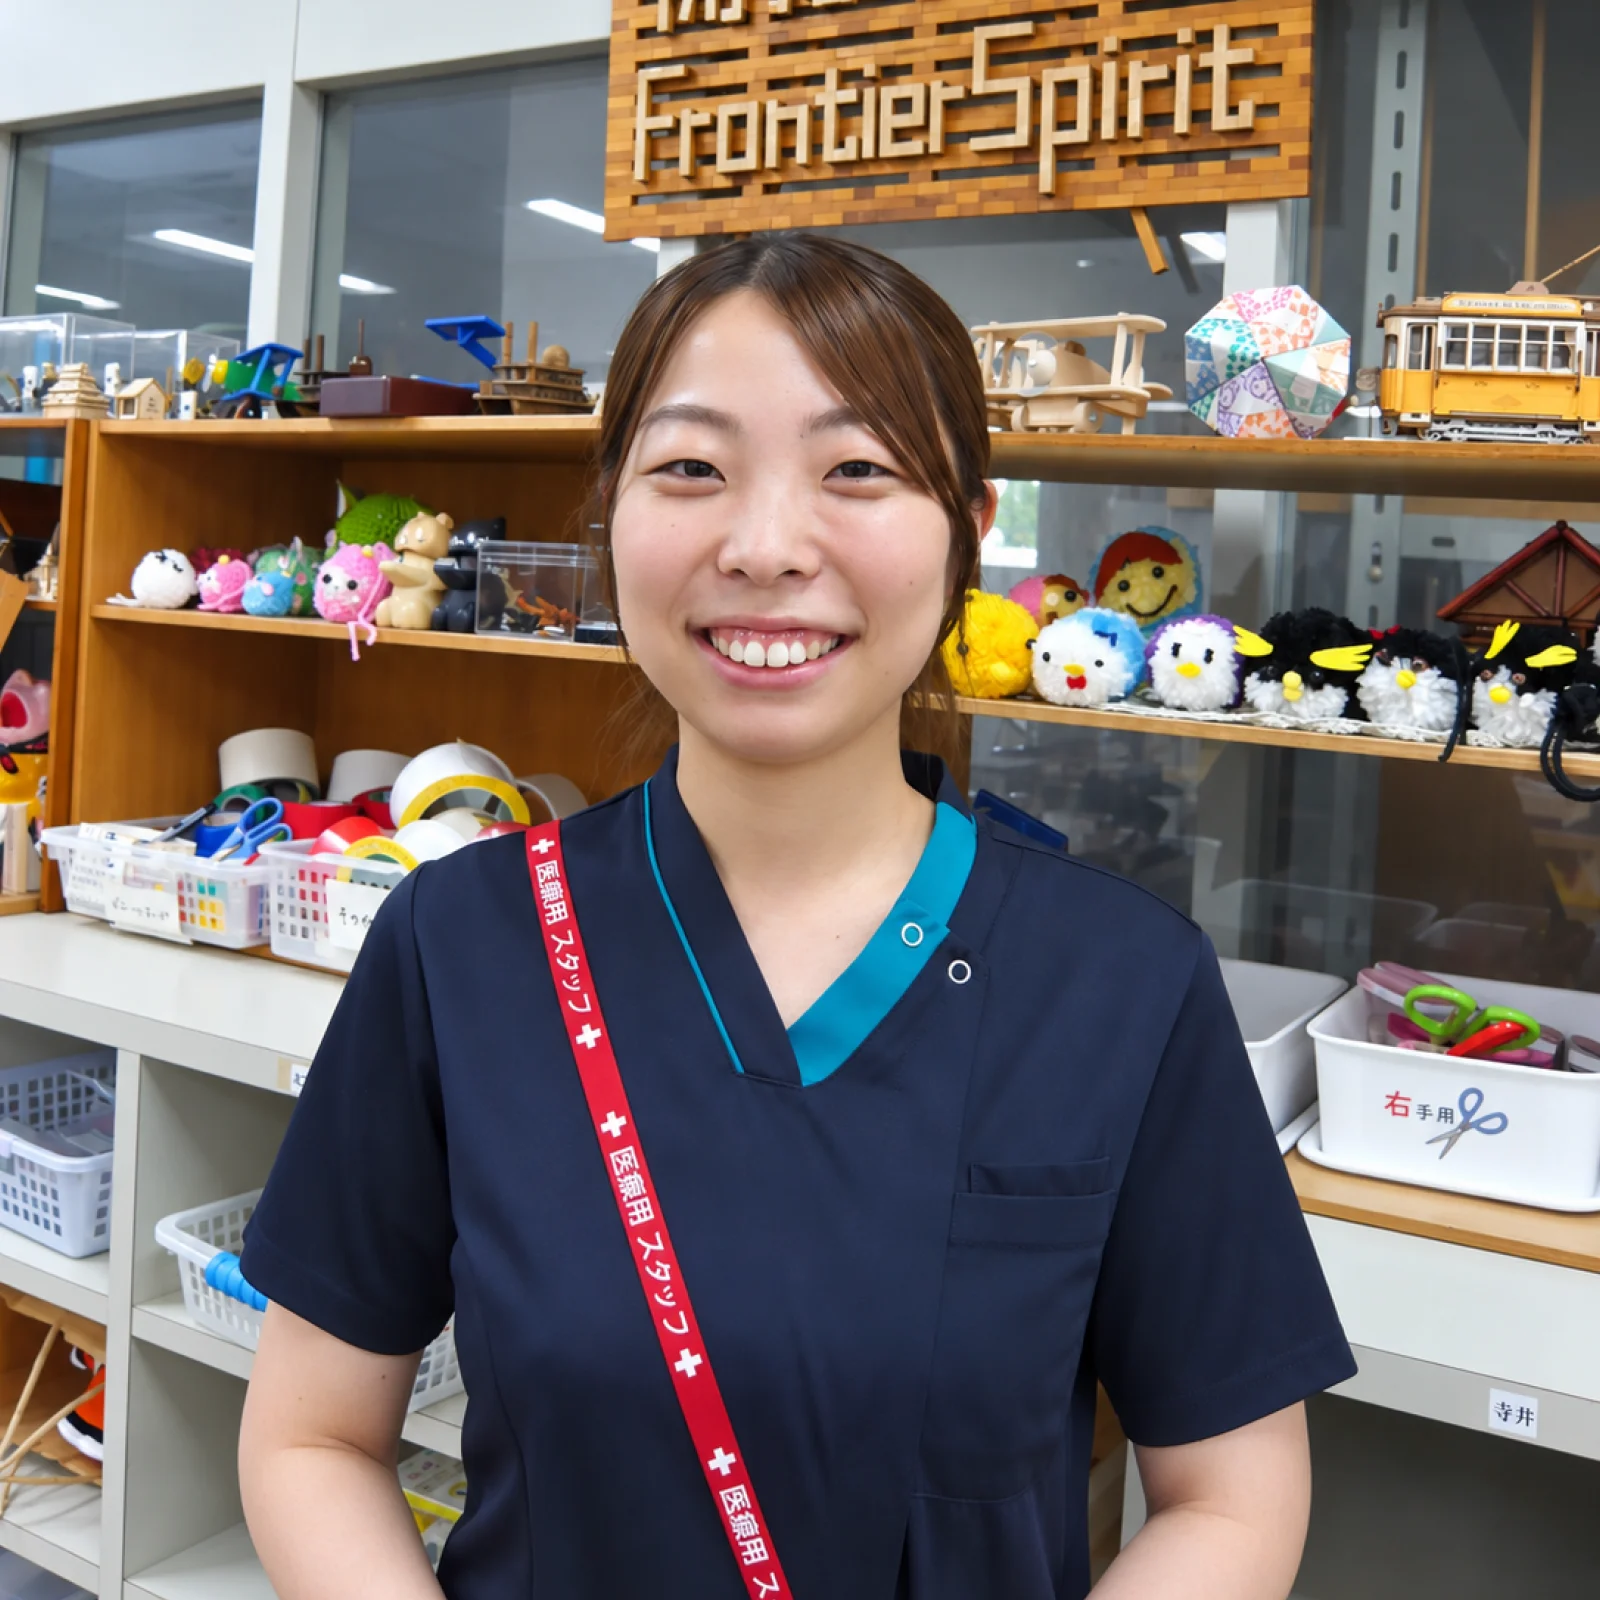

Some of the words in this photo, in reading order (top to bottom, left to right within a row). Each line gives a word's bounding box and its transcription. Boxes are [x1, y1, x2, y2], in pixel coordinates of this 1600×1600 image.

[550, 929, 592, 1014] スタッフ
[1384, 1090, 1454, 1125] 右手用
[636, 1230, 689, 1335] スタッフ
[1493, 1401, 1535, 1427] 寺井
